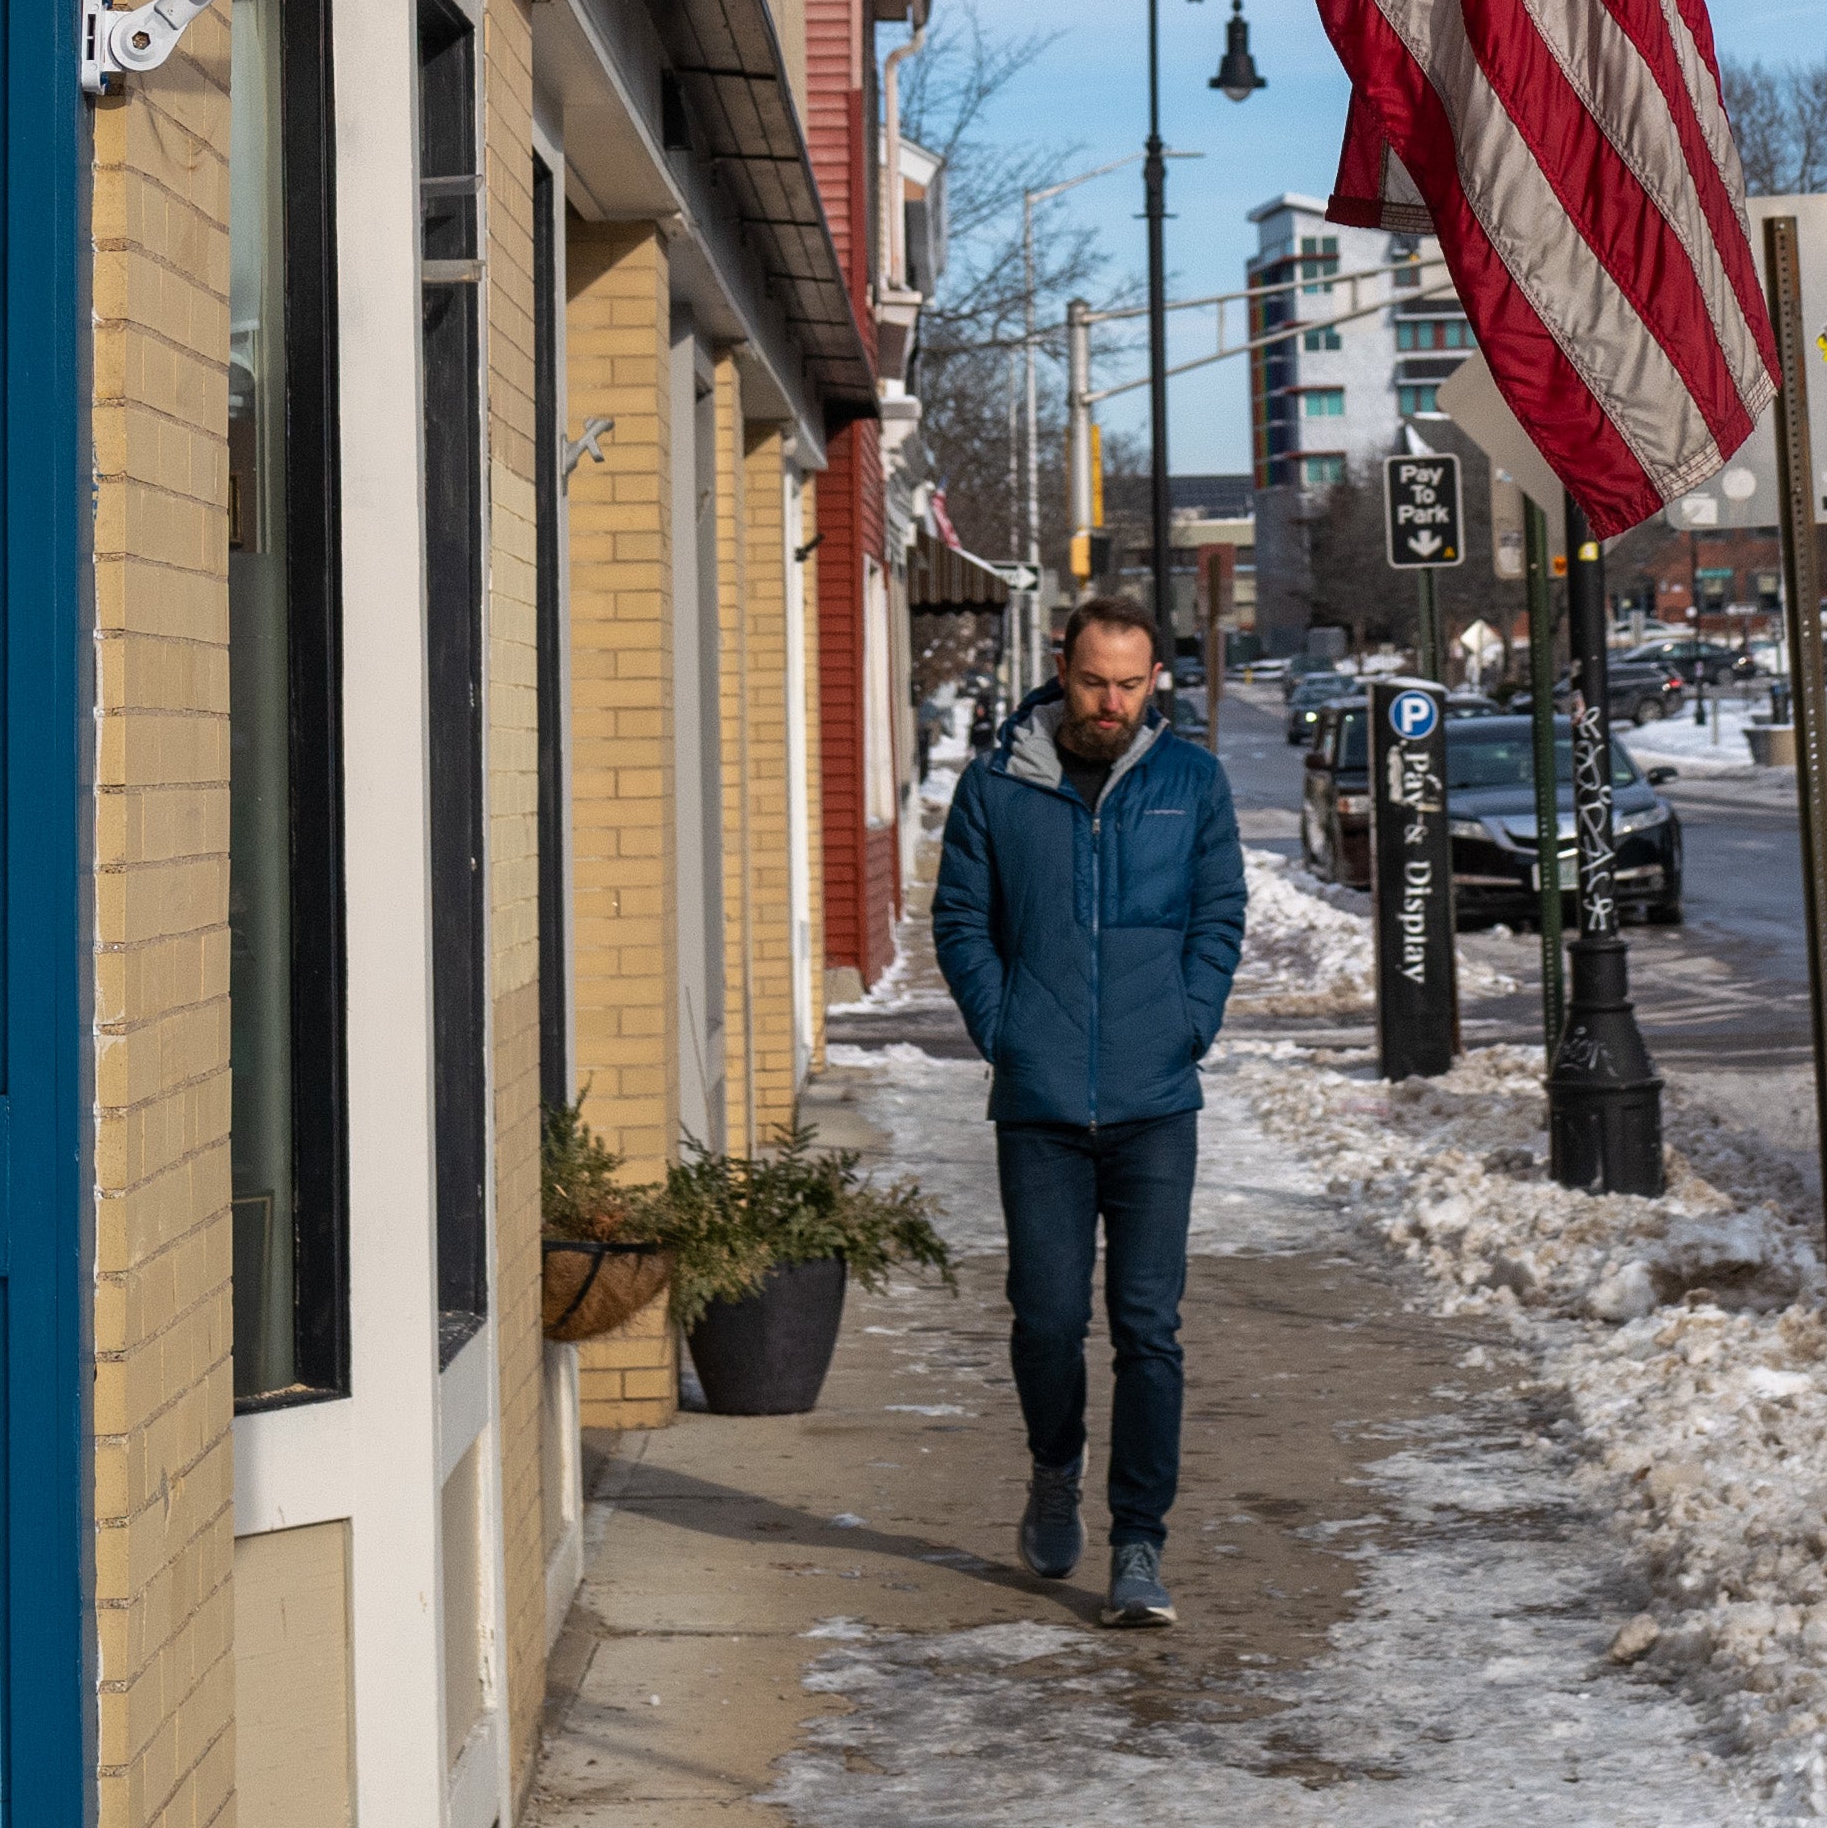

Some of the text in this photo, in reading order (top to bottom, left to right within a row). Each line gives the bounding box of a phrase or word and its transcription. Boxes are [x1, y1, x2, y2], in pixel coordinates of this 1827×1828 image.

[1400, 465, 1445, 487] Pay
[1410, 484, 1437, 505] To
[1397, 503, 1450, 526] Park
[1400, 696, 1431, 734] P
[1402, 752, 1431, 806] Pay
[1396, 860, 1433, 985] Display
